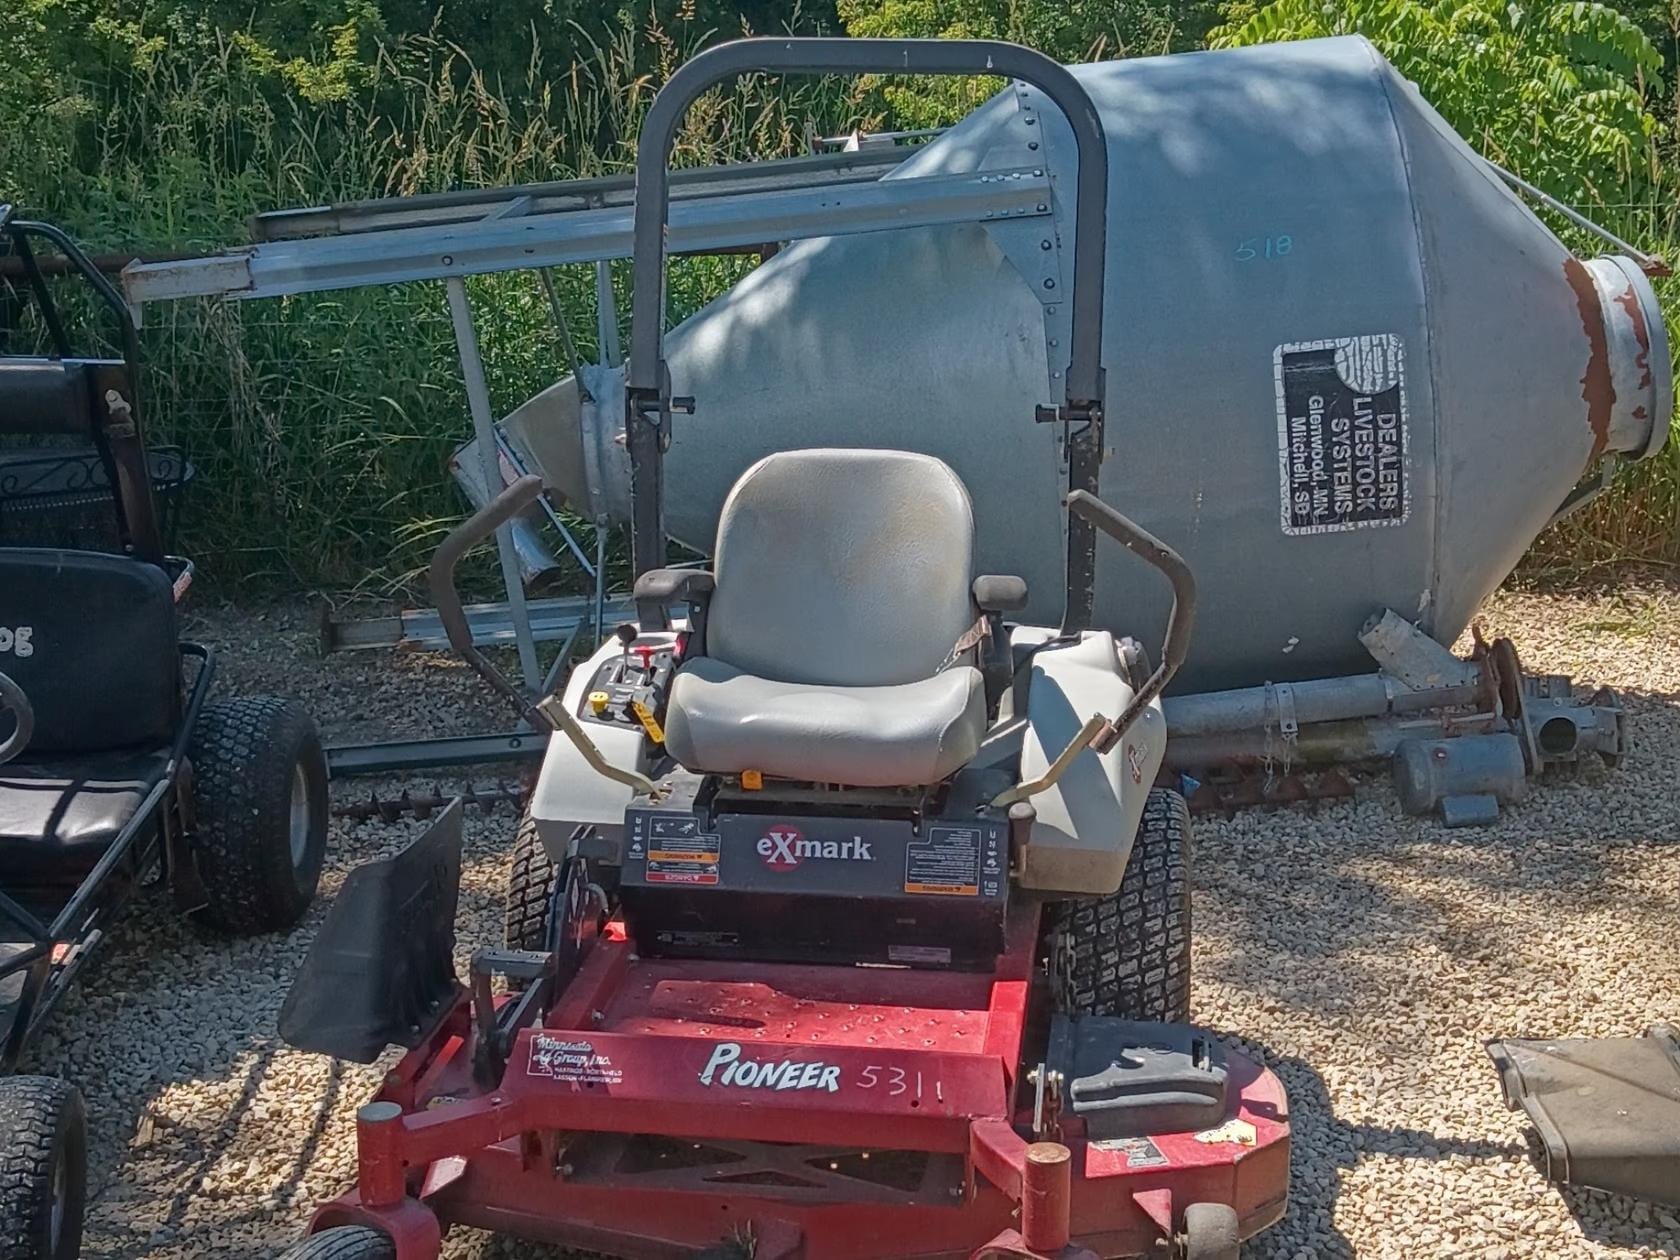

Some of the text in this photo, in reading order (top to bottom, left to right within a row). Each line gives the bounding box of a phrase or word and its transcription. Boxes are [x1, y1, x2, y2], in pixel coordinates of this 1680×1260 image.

[1233, 235, 1292, 261] 518
[1291, 416, 1309, 488] Mitchell,
[1309, 395, 1328, 515] Glenwood, MN
[1331, 418, 1353, 514] SYSTEMS
[1352, 397, 1376, 512] LIVESTOCK
[1377, 413, 1399, 511] DEALERS
[757, 832, 872, 864] eXmark
[699, 1042, 841, 1093] PIONEER
